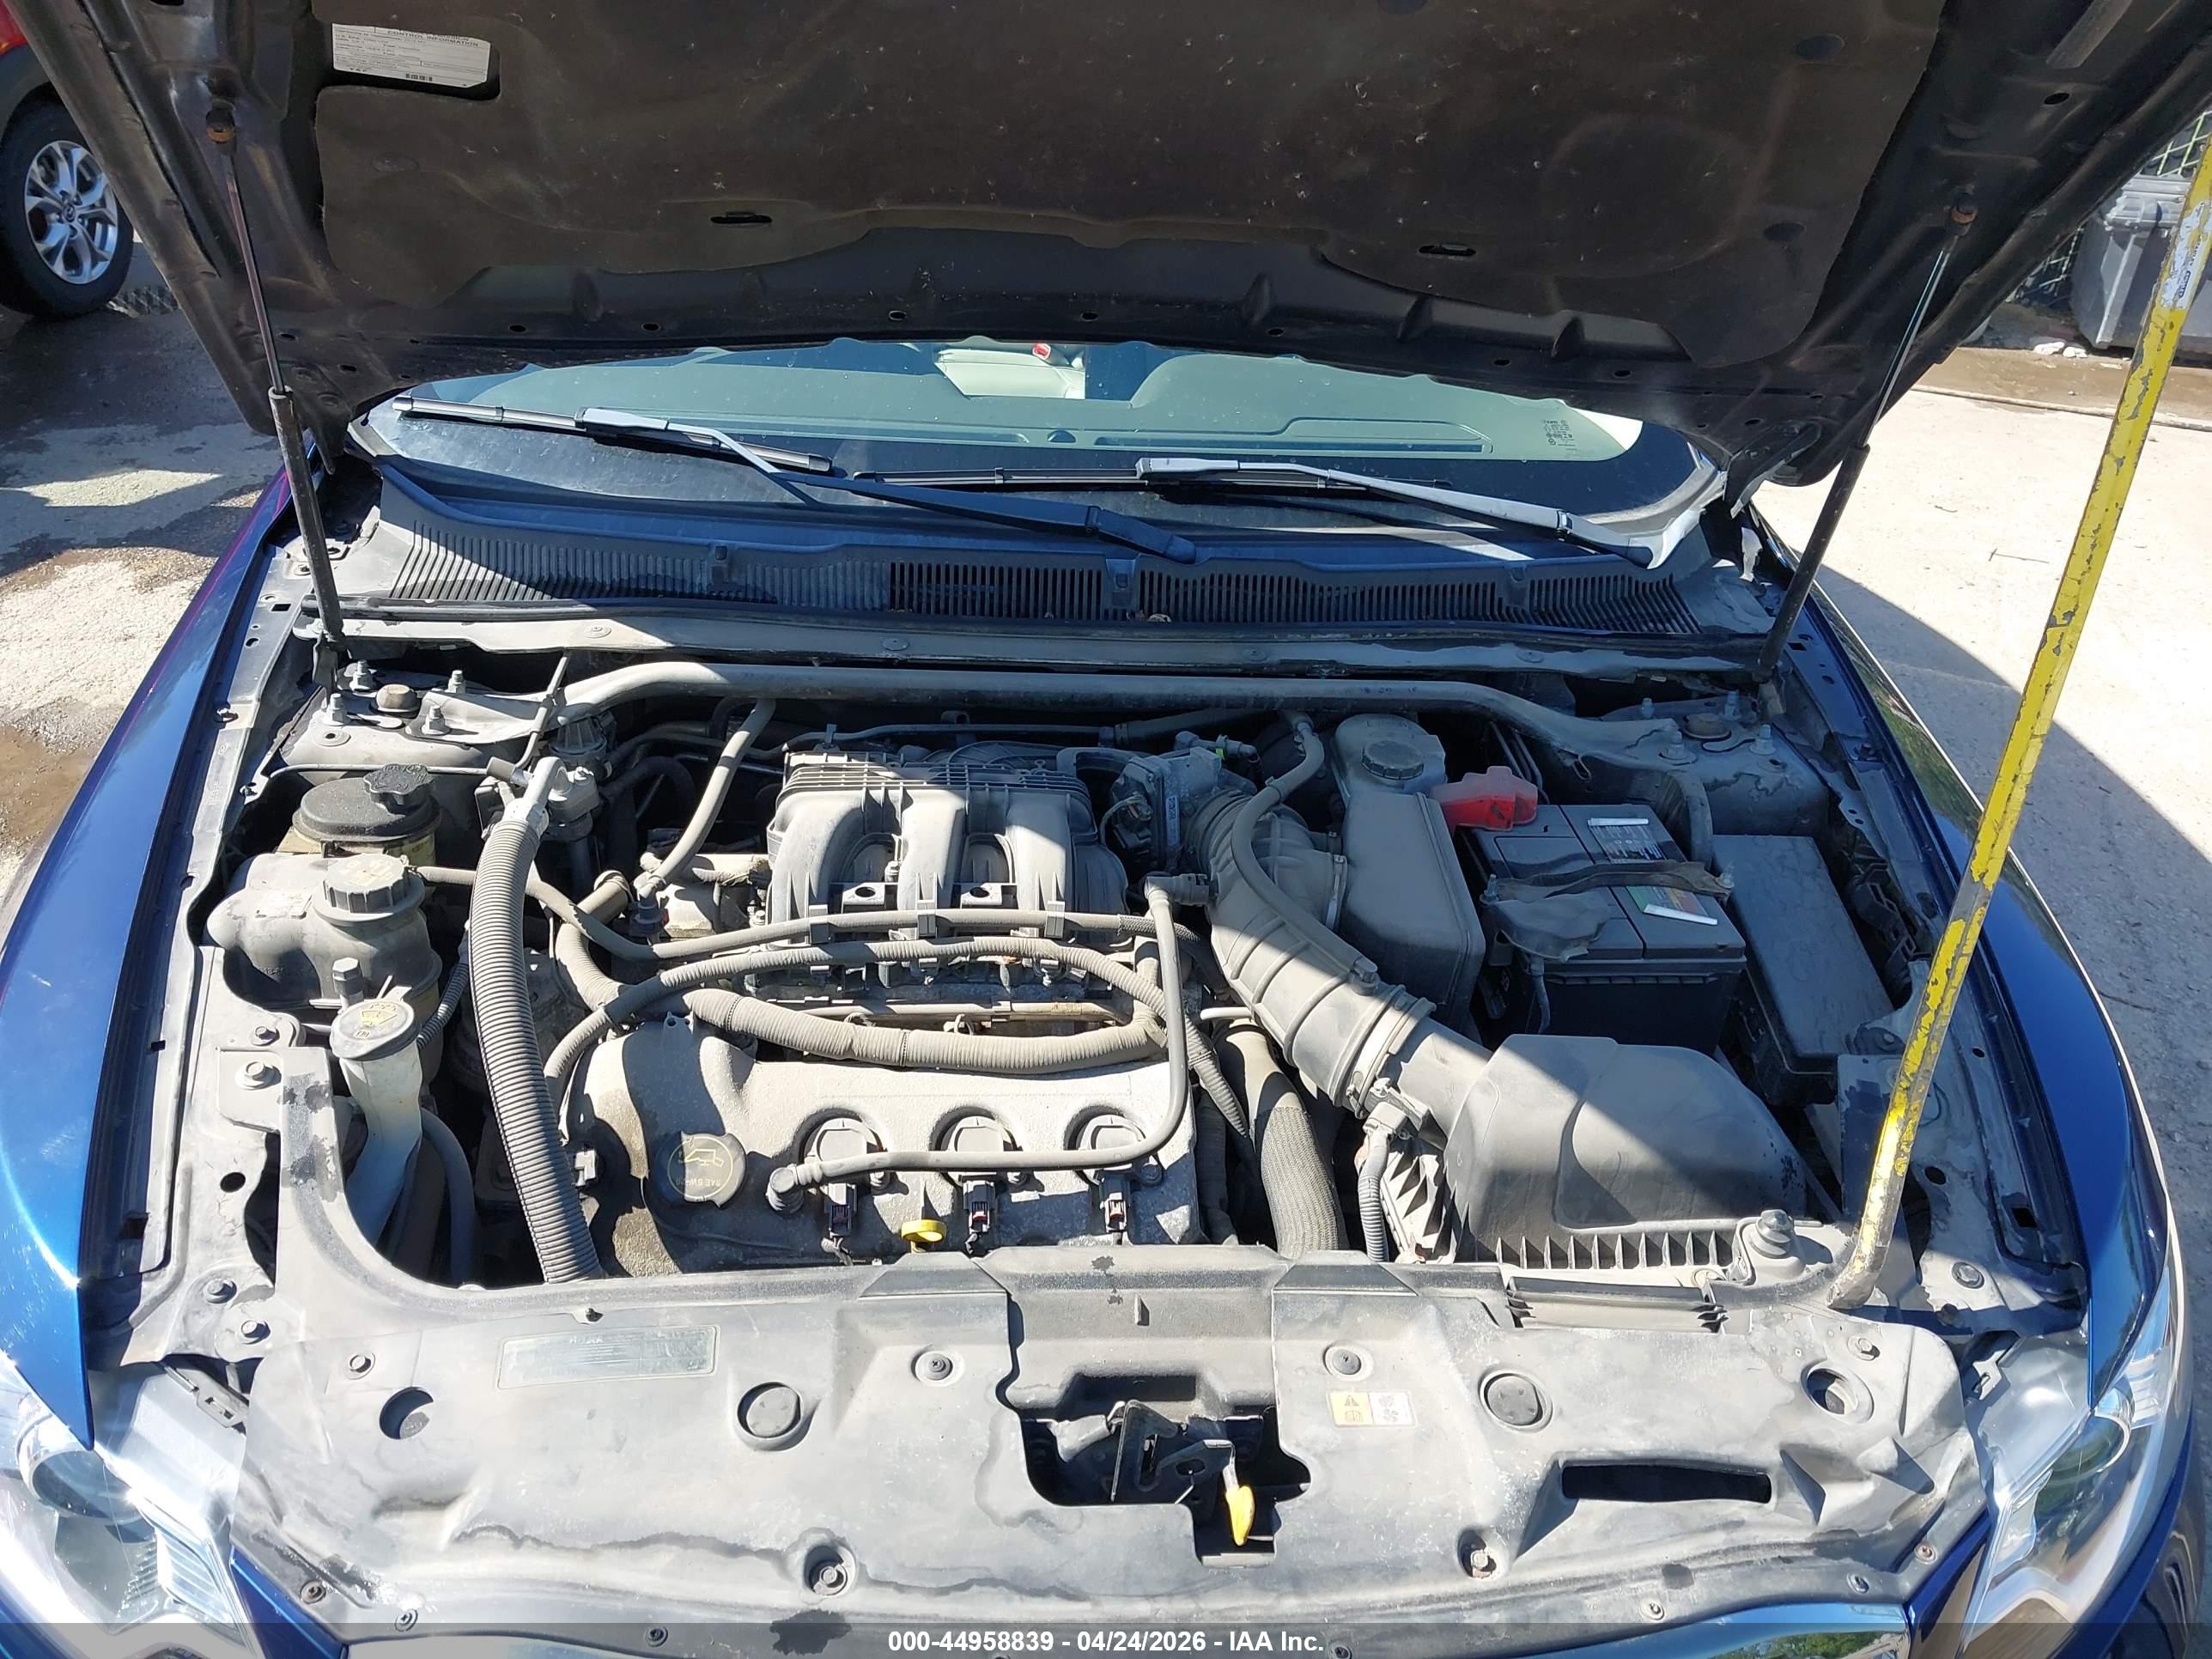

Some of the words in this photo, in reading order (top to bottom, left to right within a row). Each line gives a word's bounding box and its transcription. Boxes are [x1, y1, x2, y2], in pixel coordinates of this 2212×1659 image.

[387, 30, 423, 40] CONTROL
[426, 35, 479, 46] INFORMATION
[707, 1178, 721, 1187] SAE
